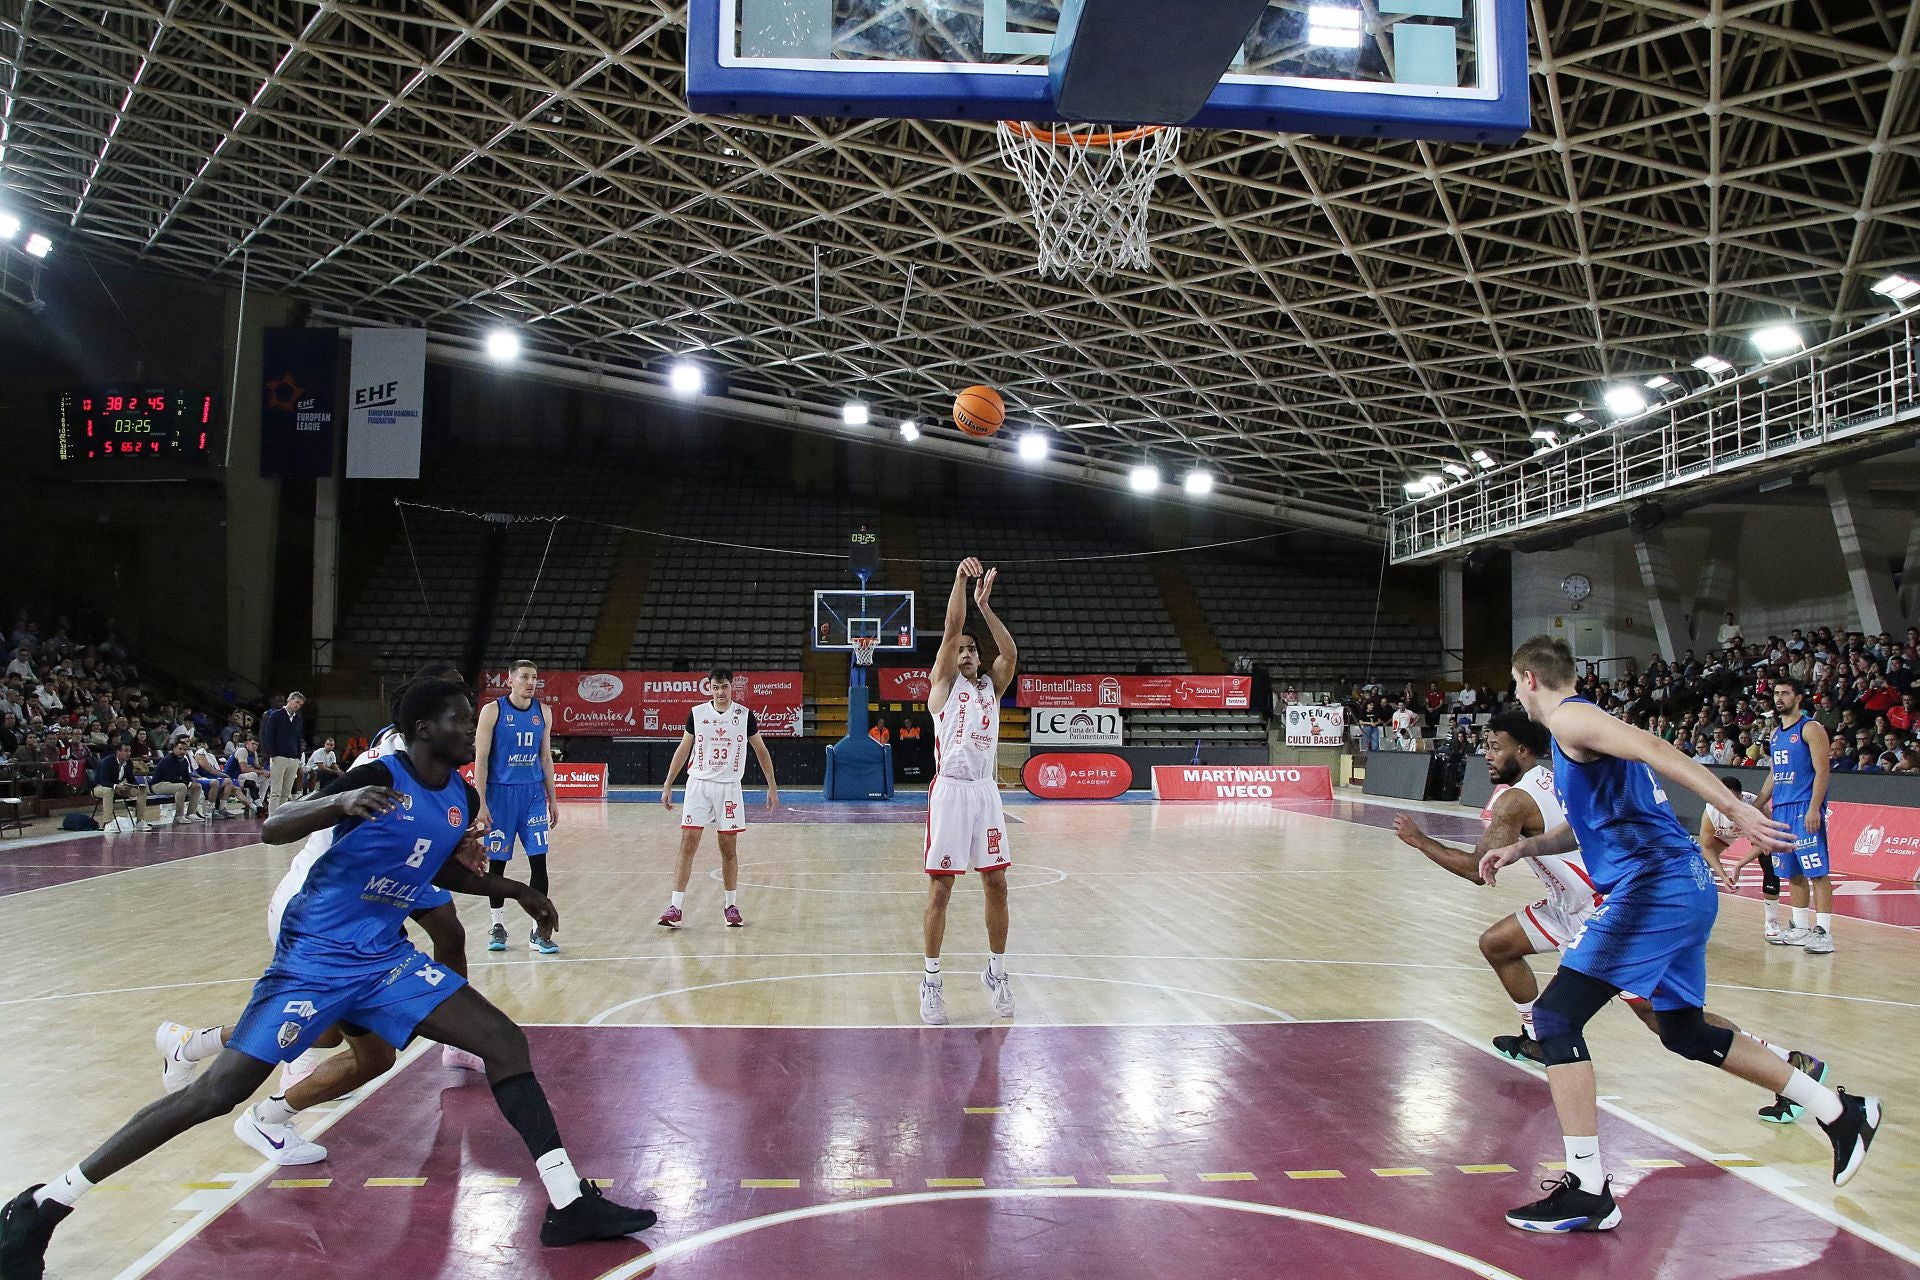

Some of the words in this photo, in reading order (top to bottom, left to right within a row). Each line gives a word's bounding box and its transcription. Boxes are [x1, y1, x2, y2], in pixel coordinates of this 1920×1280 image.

[355, 381, 398, 404] EHF
[106, 397, 123, 411] 38
[128, 398, 138, 410] 2
[148, 397, 164, 411] 45
[298, 398, 315, 408] EHF
[296, 412, 331, 422] EUROPEAN
[958, 411, 988, 433] Wilson
[115, 419, 151, 433] 03:25
[296, 421, 321, 431] LEAGUE
[104, 441, 113, 453] 5
[151, 442, 159, 452] 4
[851, 533, 876, 543] 03:25
[753, 682, 792, 691] universidad
[1035, 678, 1092, 692] DentalClass
[1196, 687, 1220, 695] Solucyl
[758, 688, 773, 696] león
[1103, 688, 1117, 703] R3
[563, 706, 623, 723] Cervantes
[1301, 707, 1331, 721] PEÑA
[661, 722, 686, 732] Aguas
[980, 715, 991, 731] 9
[516, 731, 534, 747] 10
[1287, 735, 1312, 745] CULTU
[1313, 735, 1342, 745] BASKET
[713, 748, 728, 760] 33
[1773, 749, 1789, 765] 65
[570, 771, 600, 782] Suites
[1069, 769, 1118, 779] ASPIRE
[1183, 769, 1301, 783] MARTINAUTO
[1216, 785, 1273, 798] IVECO
[1883, 837, 1920, 849] ASPIR
[405, 838, 432, 869] 8
[1884, 848, 1916, 856] ACADEMY
[1800, 853, 1822, 870] 65
